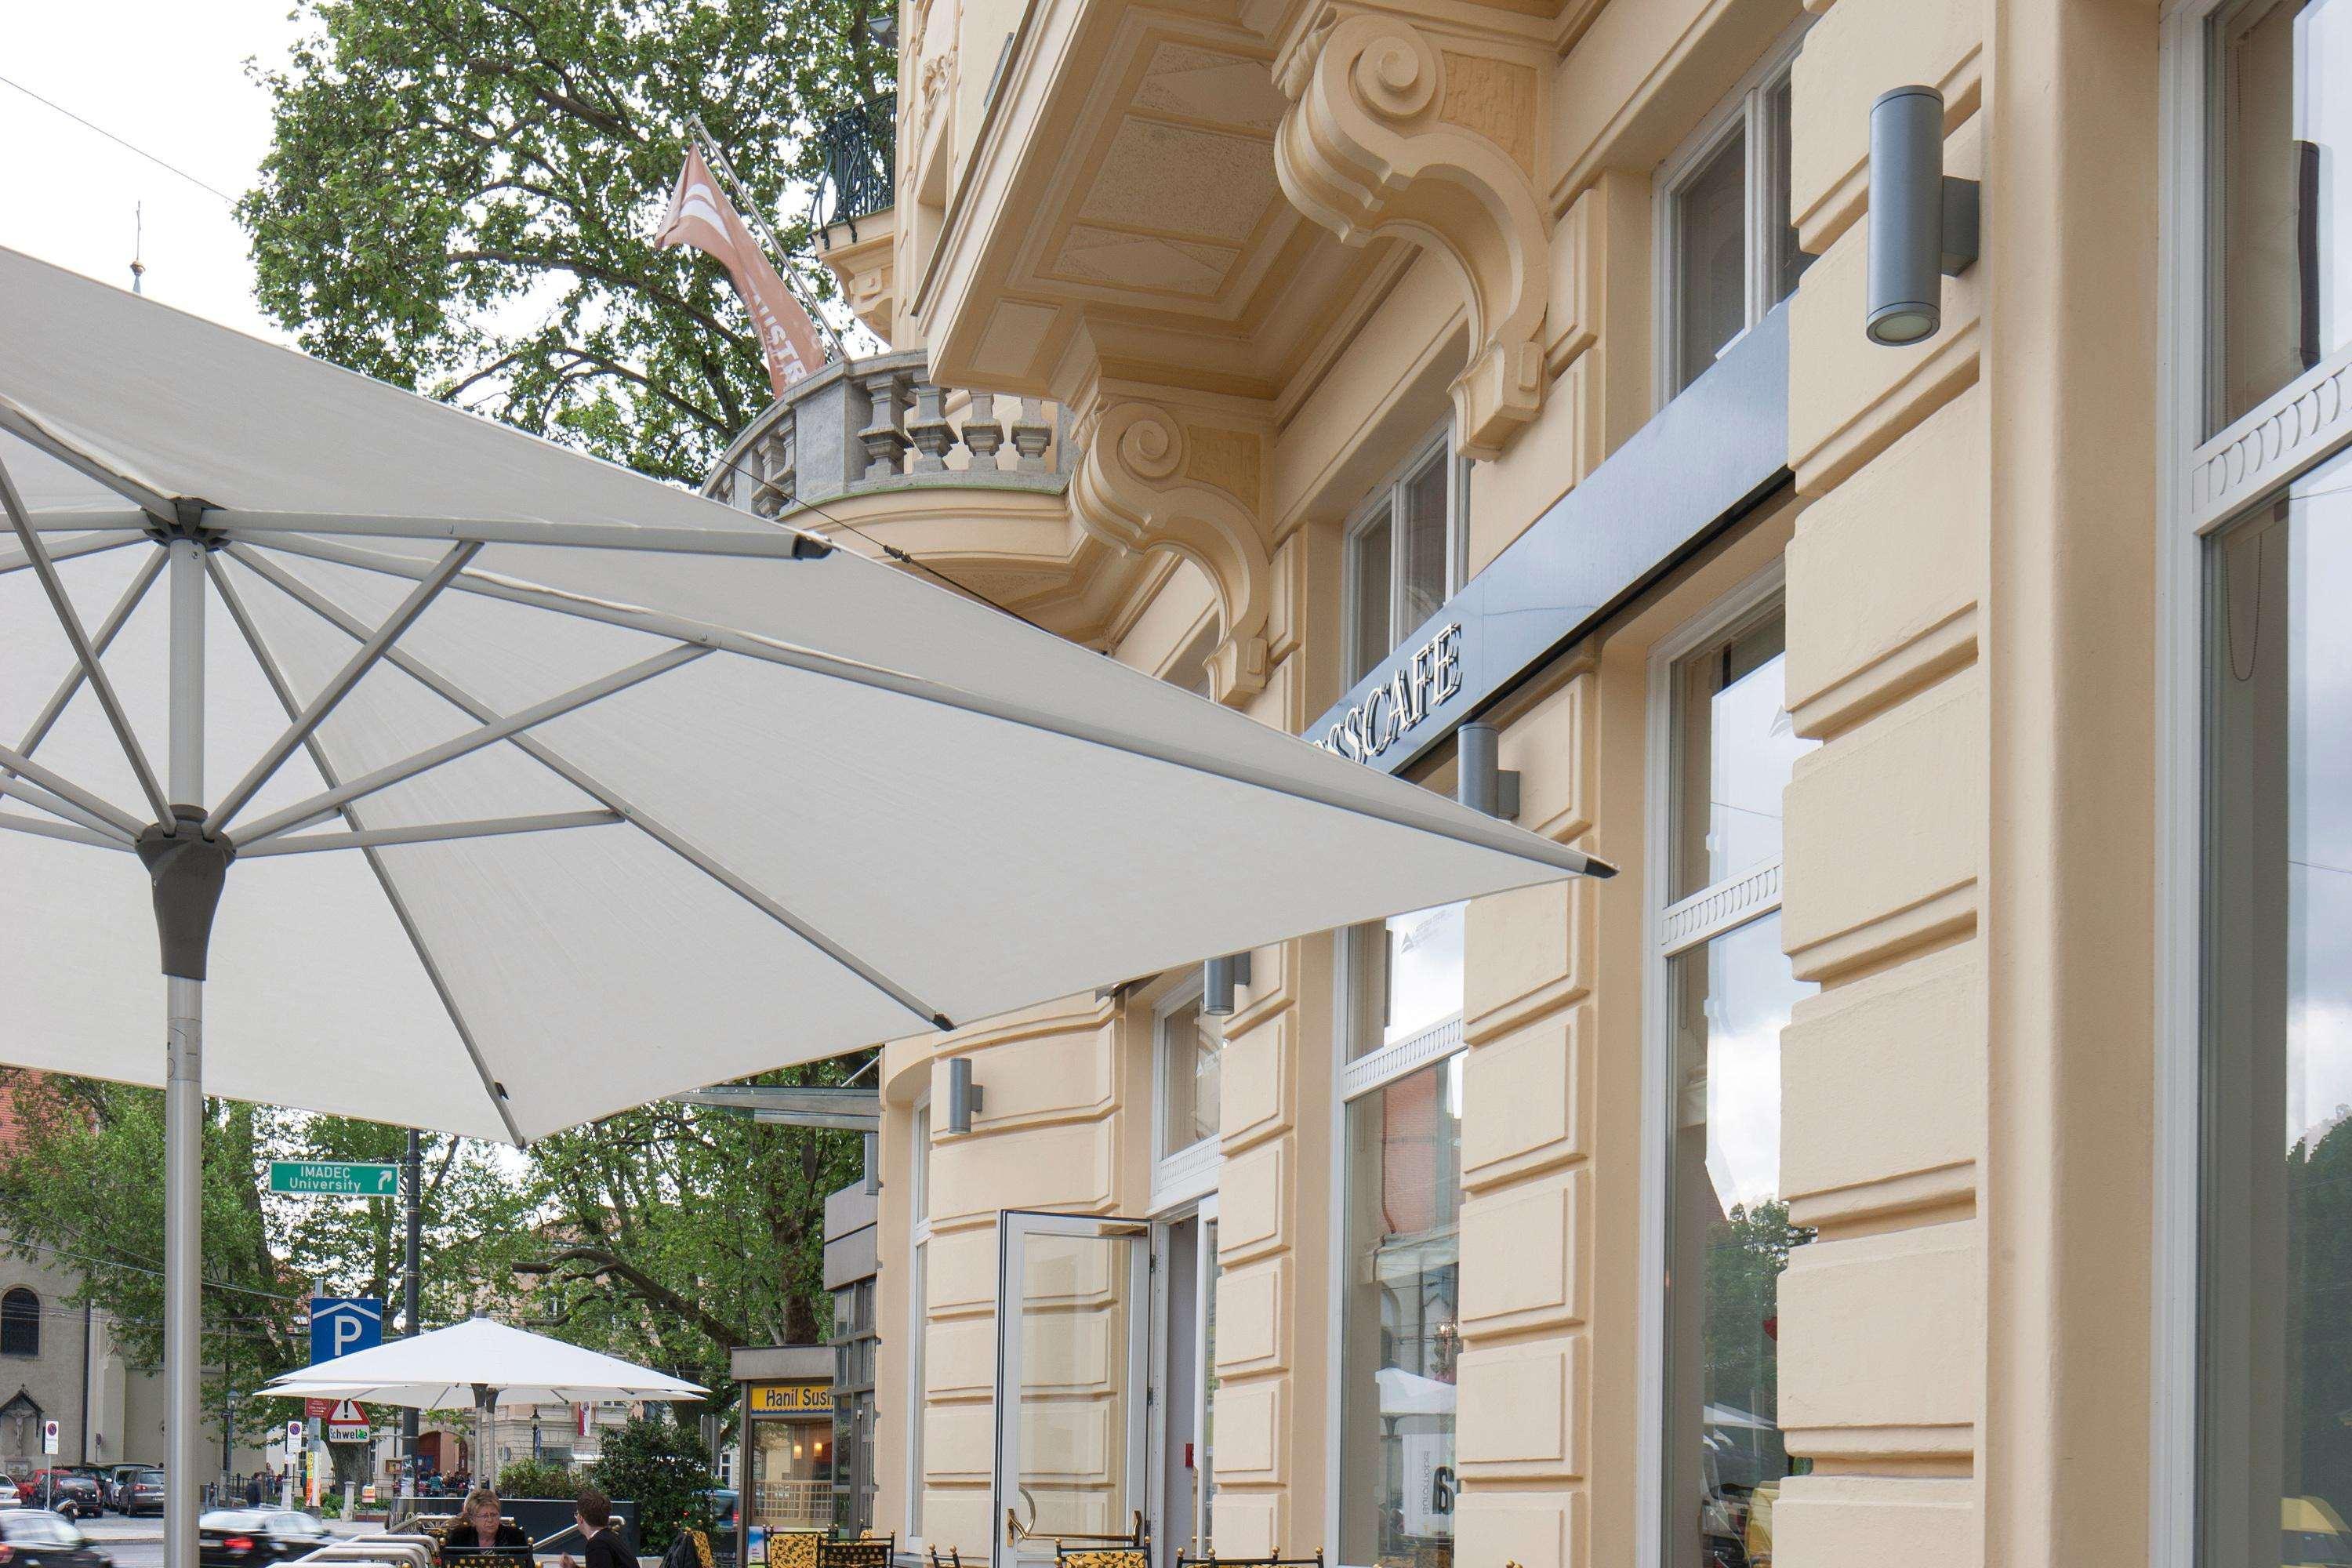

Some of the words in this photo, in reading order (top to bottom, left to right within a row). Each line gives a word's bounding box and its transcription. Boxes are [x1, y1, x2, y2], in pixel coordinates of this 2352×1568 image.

[1314, 622, 1463, 764] SSCAFE
[300, 1165, 351, 1178] IMADEC
[289, 1177, 361, 1192] University
[334, 1315, 362, 1356] P
[766, 1388, 798, 1406] Hanil
